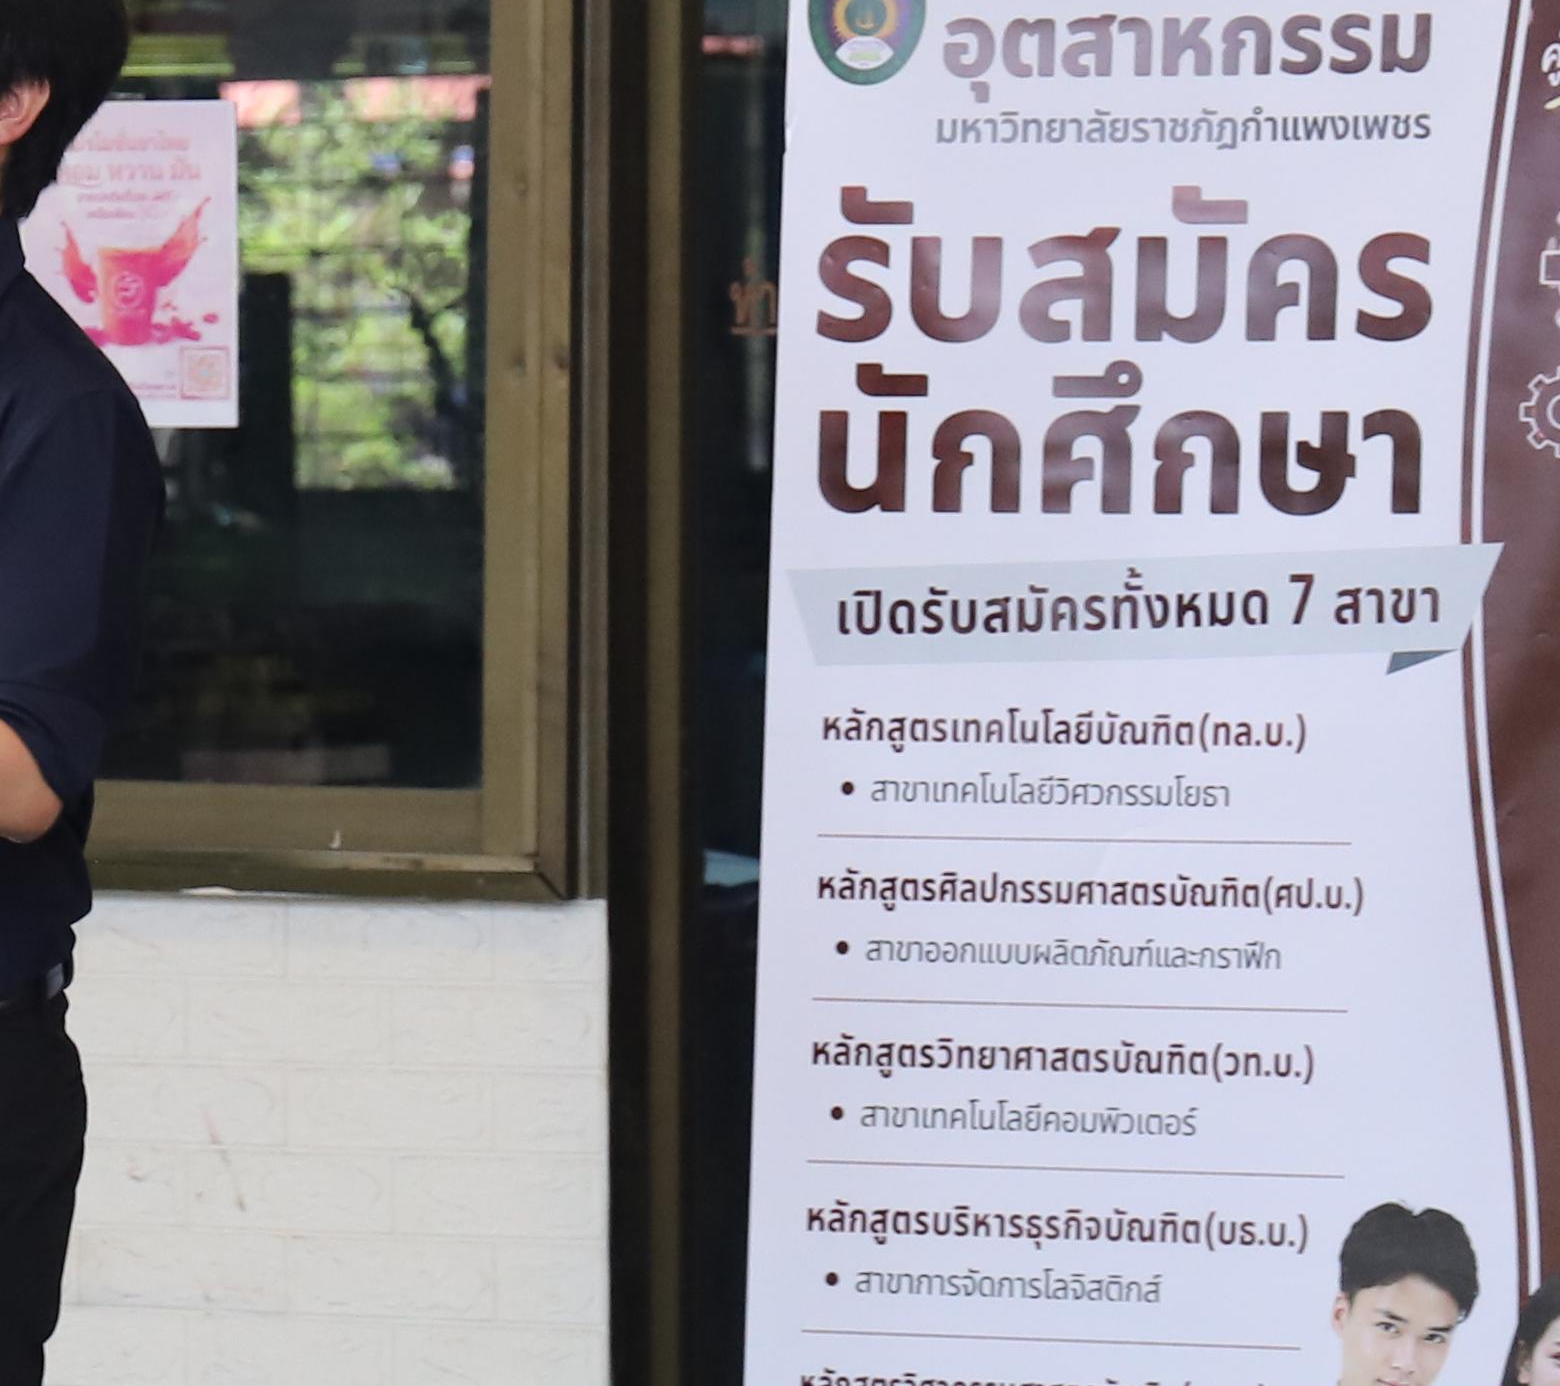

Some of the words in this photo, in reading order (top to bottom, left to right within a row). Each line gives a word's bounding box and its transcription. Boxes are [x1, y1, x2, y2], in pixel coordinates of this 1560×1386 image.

[942, 9, 1434, 103] อุตสาหกรรม
[815, 184, 1435, 344] รับสมัคร
[816, 358, 1422, 517] นักศึกษา
[836, 567, 1270, 637] เปิดรับสมัครทั้งหมด
[1288, 573, 1316, 625] 7
[1333, 581, 1442, 627] สาขา
[821, 707, 1307, 755] หลักสูตรเทคโนโลยีบัณฑิต(ทล.บ.)
[870, 773, 1232, 808] สาขาเทคโนโลยีวิศวกรรมโยธา
[810, 1034, 1315, 1084] หลักสูตรวิทยาศาสตรบัณฑิต(วท.บ.)
[806, 1202, 1309, 1254] หลักสูตรบริหารธุรกิจบัณฑิต(บธ.บ.)
